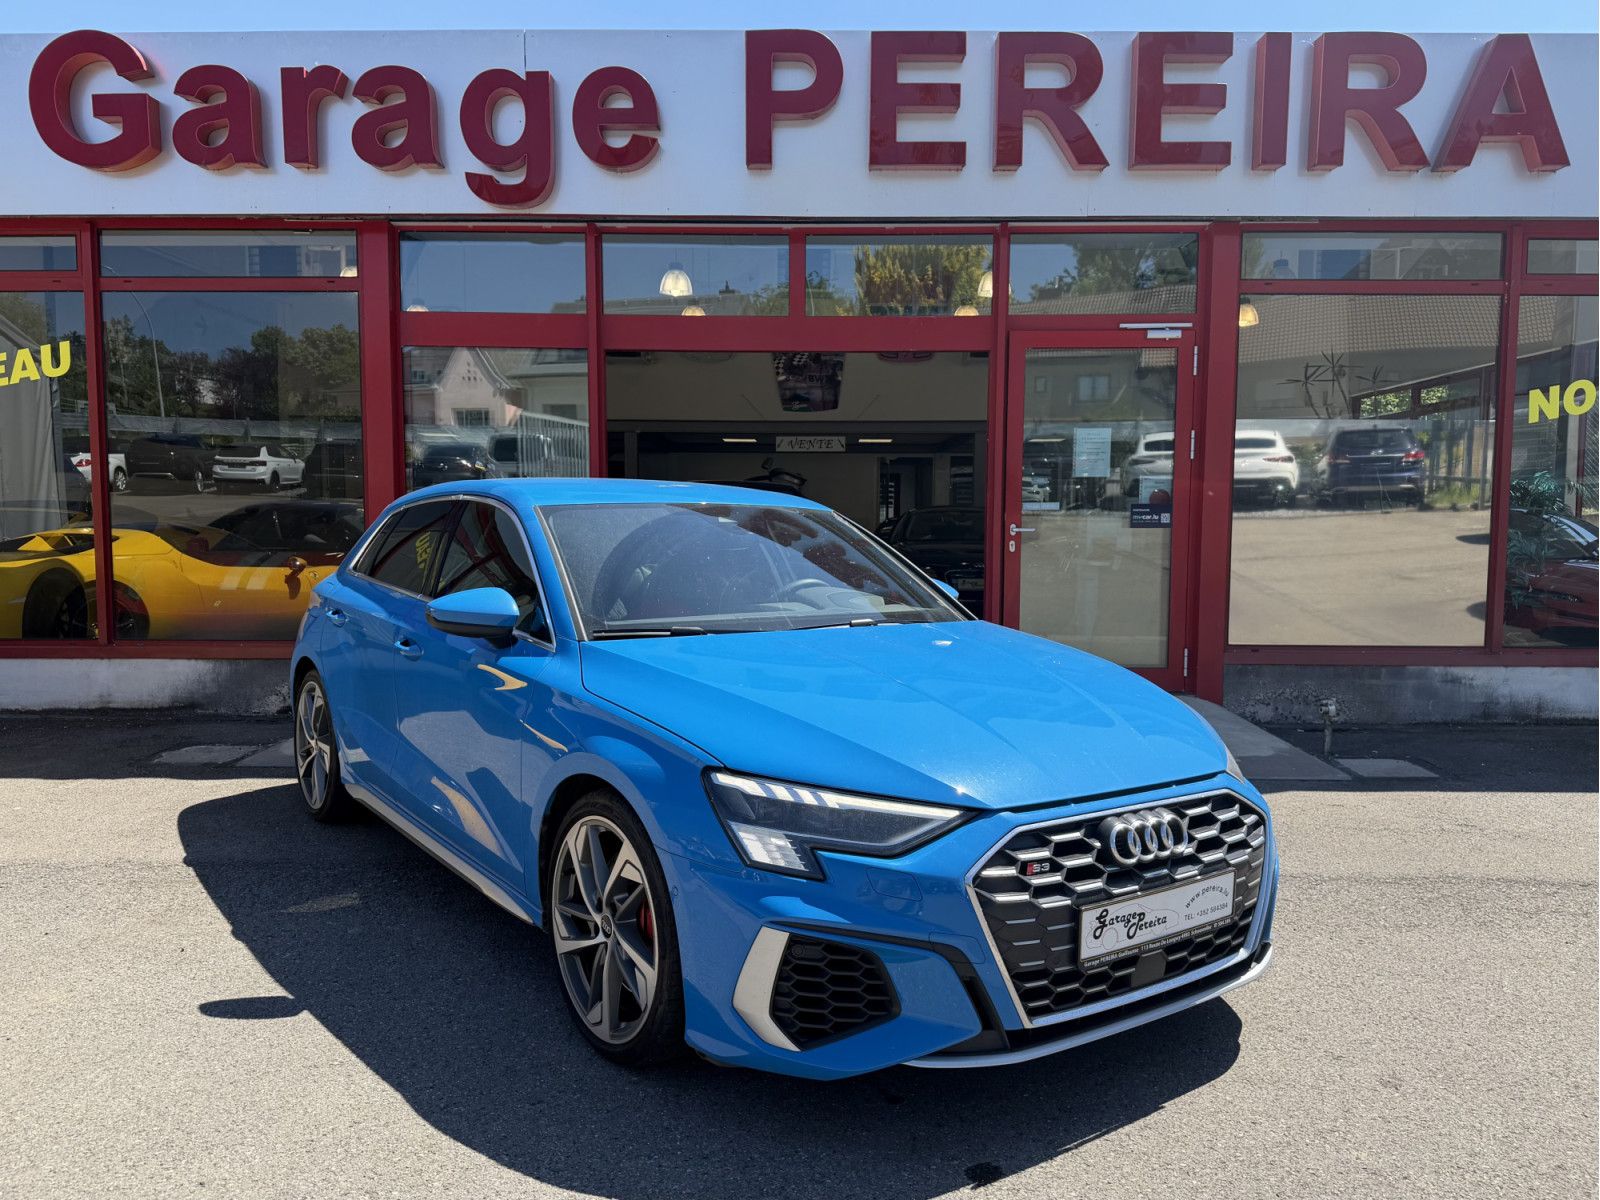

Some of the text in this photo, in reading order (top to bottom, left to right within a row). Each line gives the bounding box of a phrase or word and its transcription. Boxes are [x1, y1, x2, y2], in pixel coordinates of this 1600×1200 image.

[28, 29, 1571, 209] Garage PEREIRA
[1528, 379, 1597, 424] NO
[787, 436, 833, 450] VENTE
[1032, 862, 1050, 873] S3
[1093, 909, 1138, 941] Garage
[1127, 912, 1167, 941] Pereira
